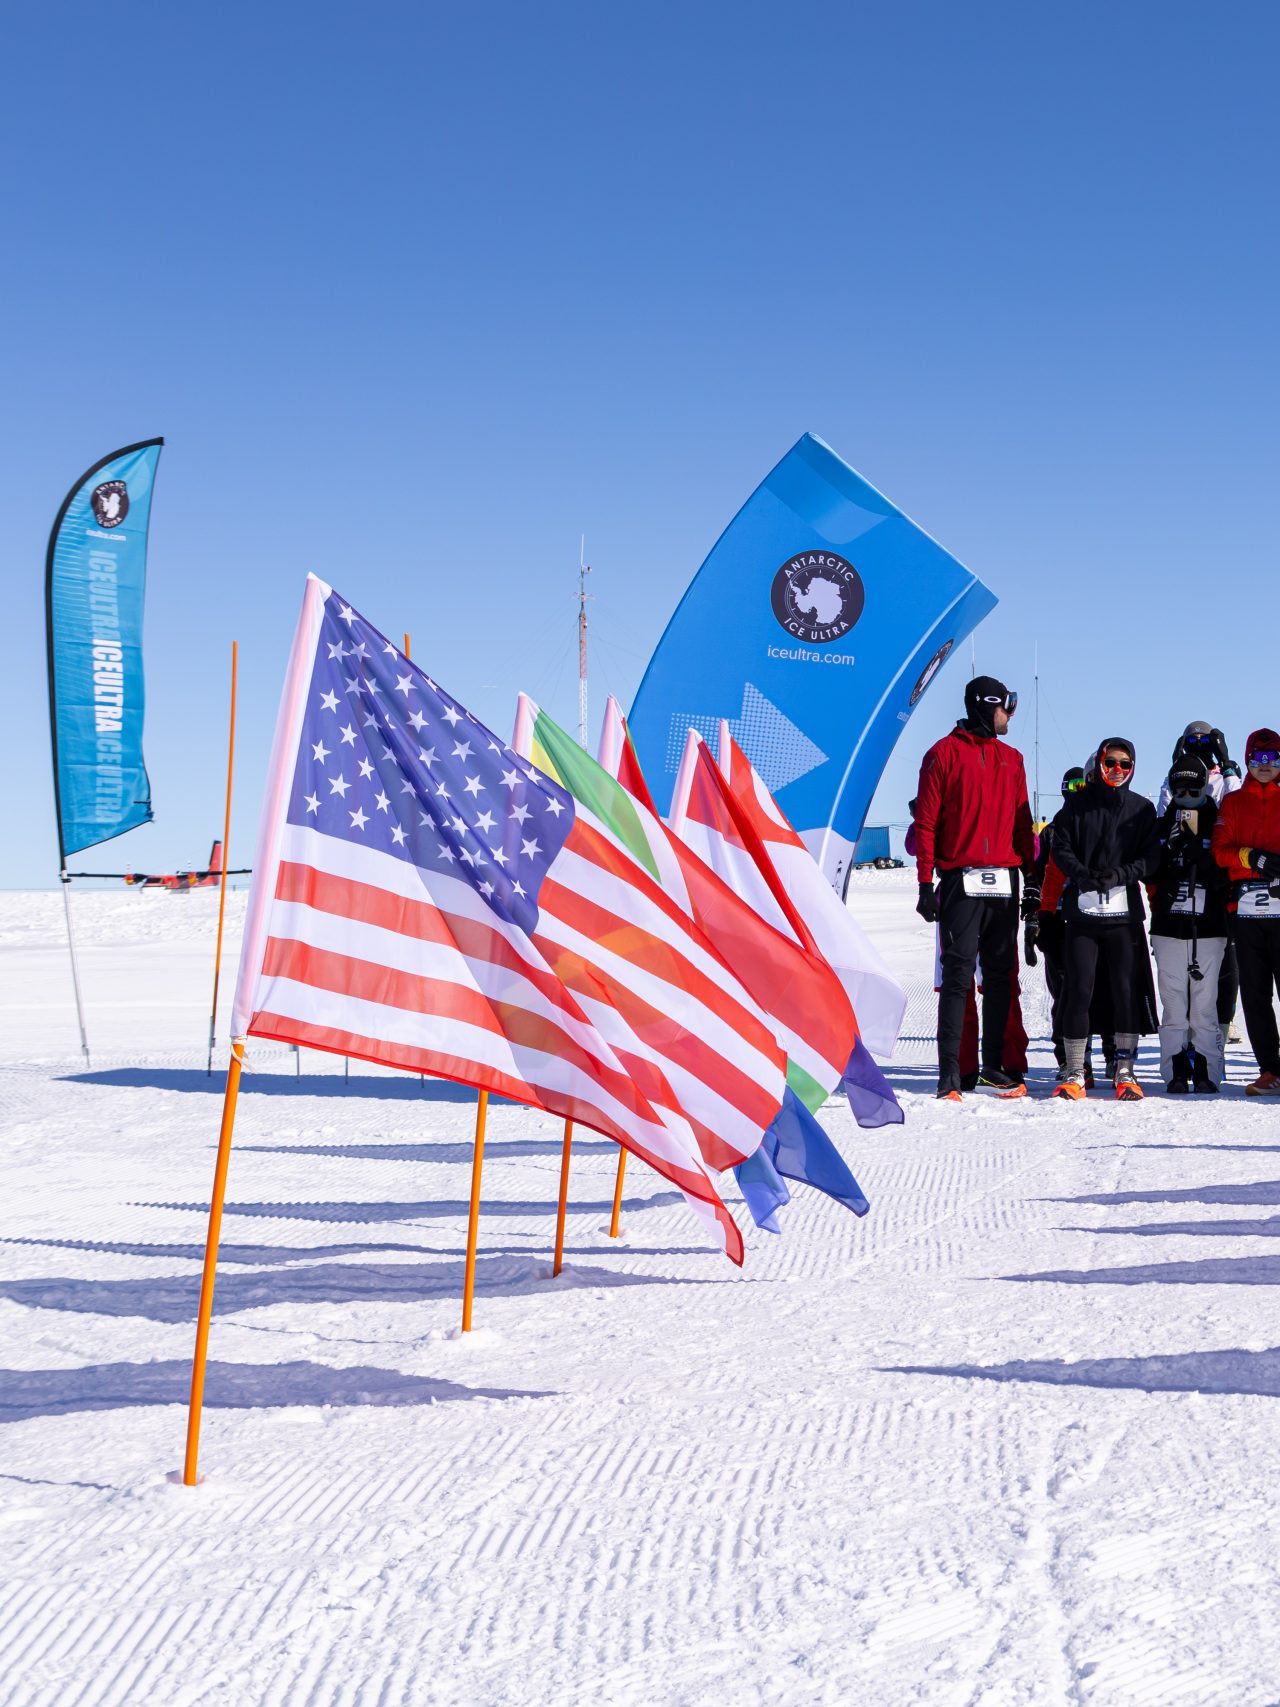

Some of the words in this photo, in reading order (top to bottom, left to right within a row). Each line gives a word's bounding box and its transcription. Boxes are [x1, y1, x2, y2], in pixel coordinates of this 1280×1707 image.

[784, 555, 854, 581] ANTARCTIC
[784, 617, 804, 637] ICE
[811, 621, 849, 640] ULTRA
[767, 645, 855, 666] iceultra.com
[92, 639, 124, 732] ICEULTRA
[981, 872, 996, 885] 8
[1255, 893, 1269, 906] 2
